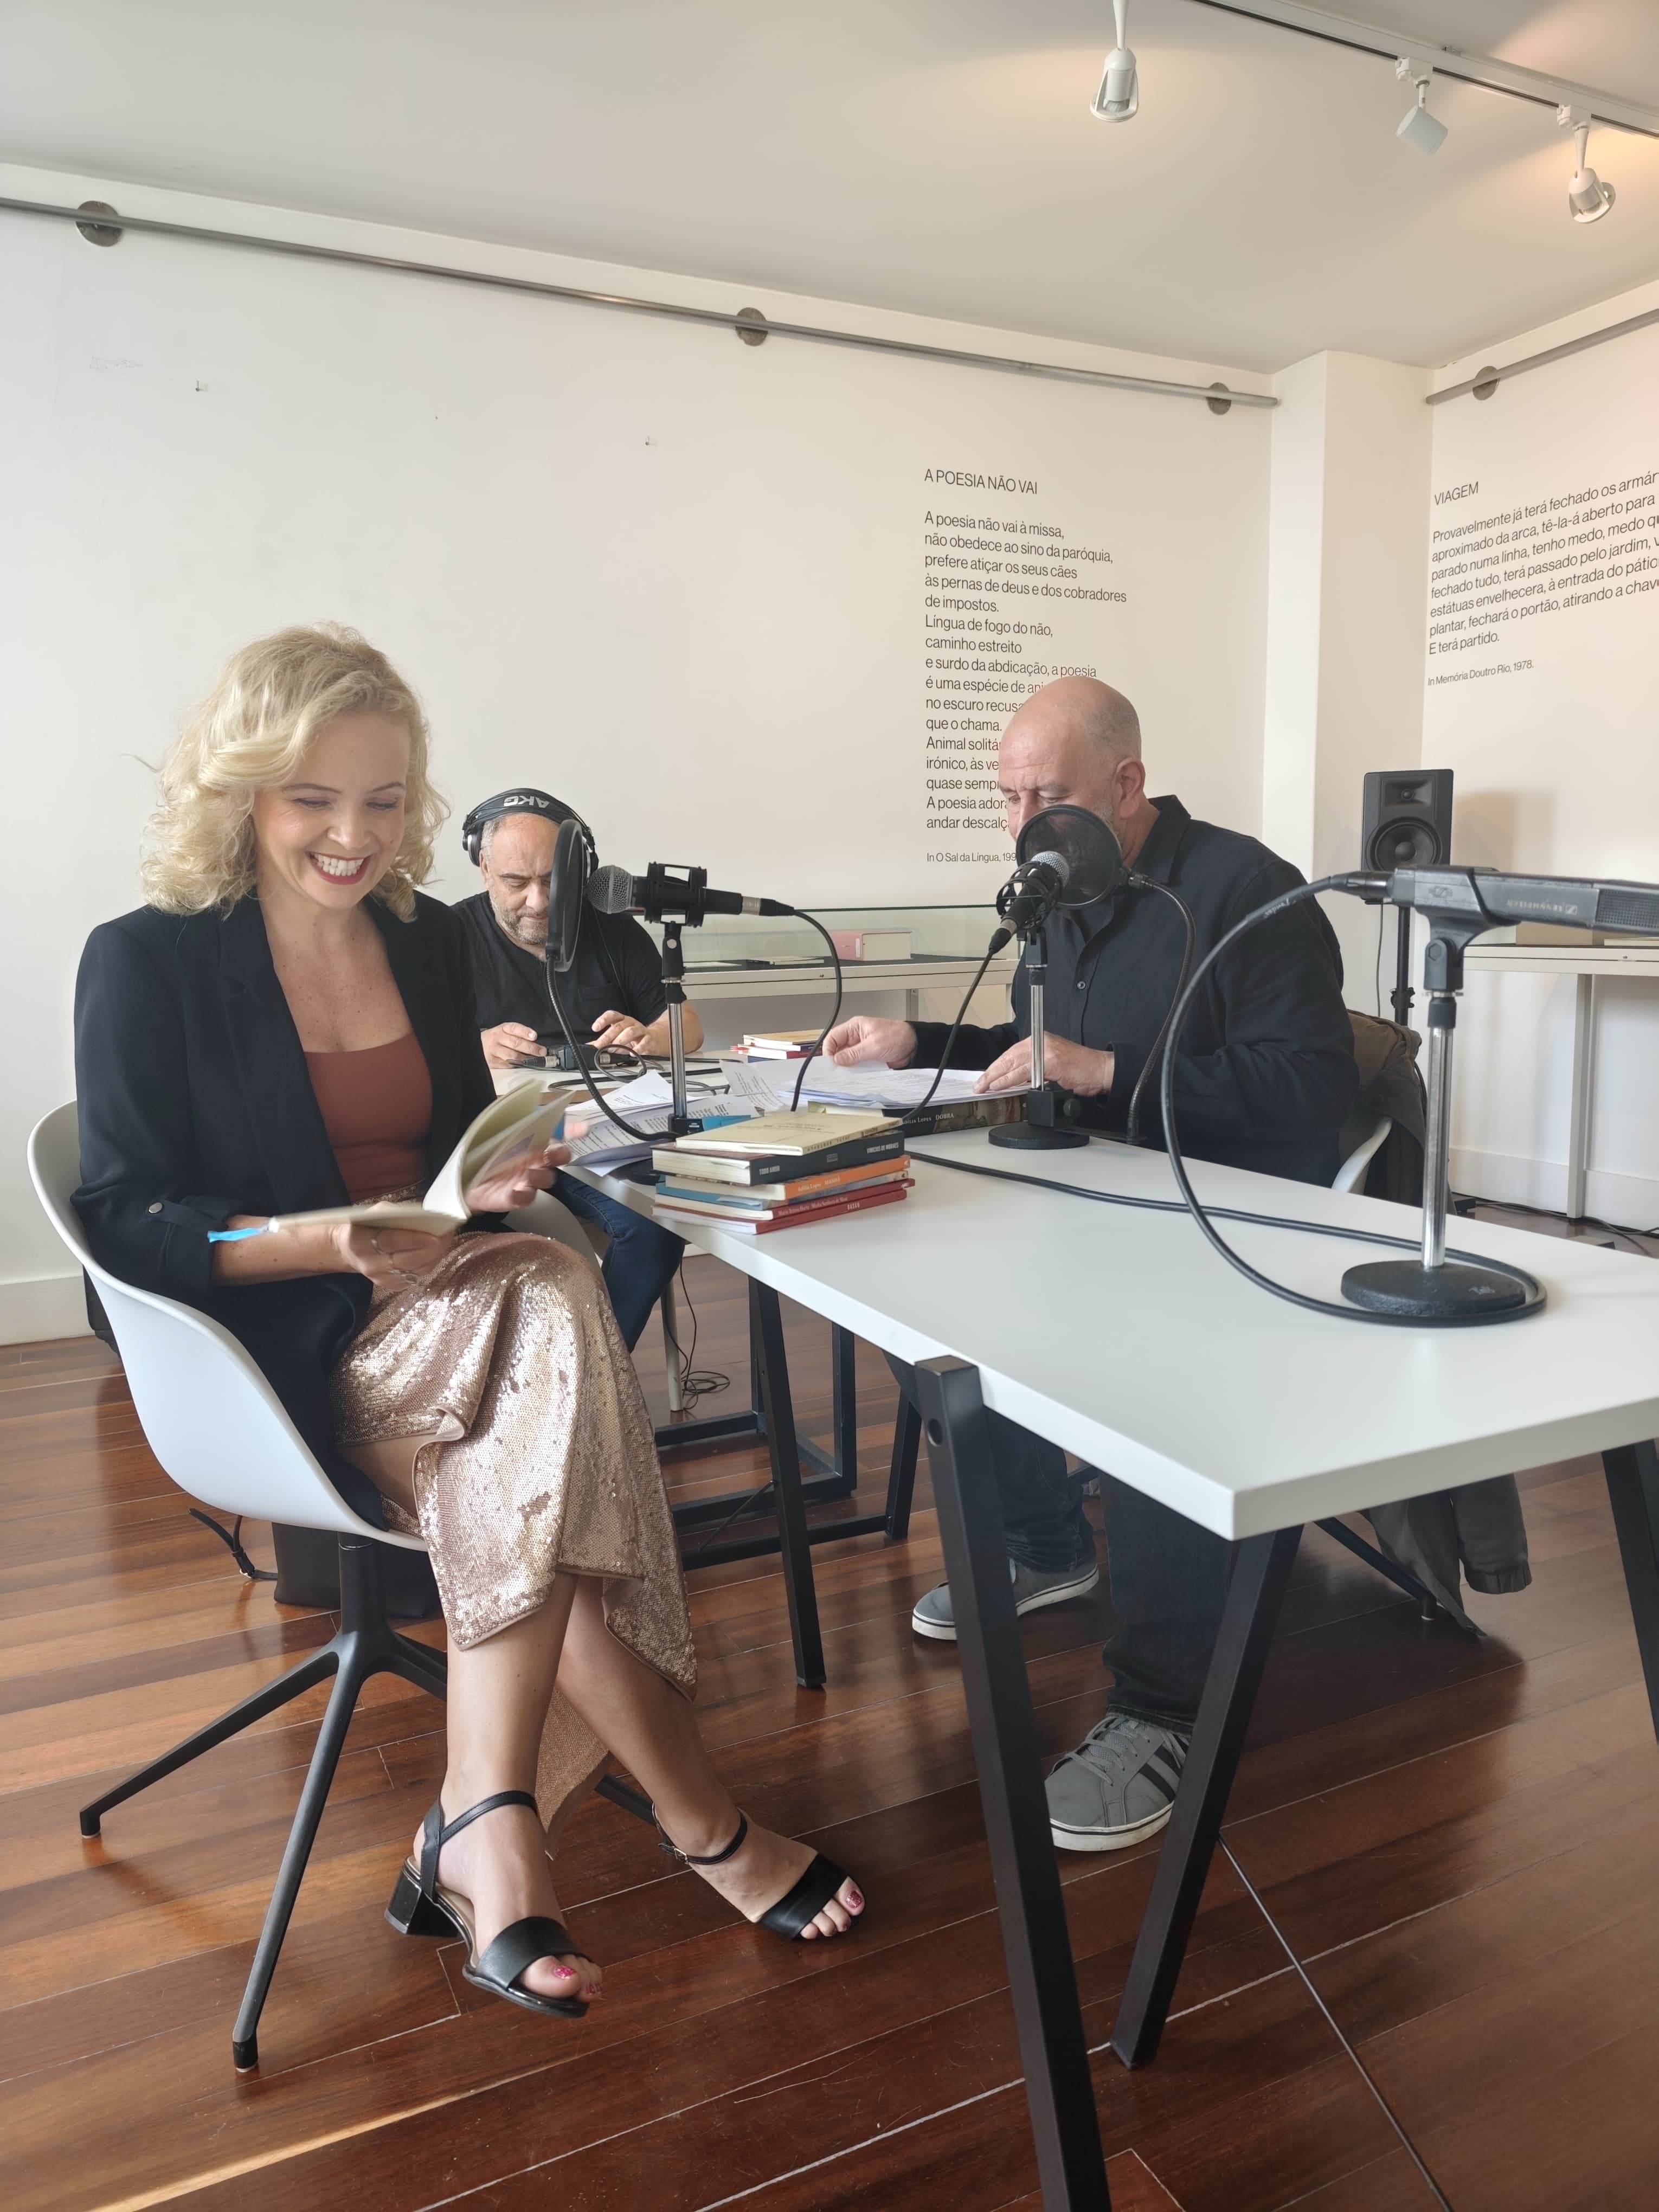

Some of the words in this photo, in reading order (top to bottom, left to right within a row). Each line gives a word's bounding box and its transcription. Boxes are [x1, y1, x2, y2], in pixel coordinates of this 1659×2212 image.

[924, 469, 934, 482] A
[937, 470, 985, 488] POESIA
[988, 475, 1015, 492] NÃO
[1019, 480, 1037, 494] VAI
[1435, 481, 1478, 505] VIAGEM
[1433, 513, 1510, 543] Provavelmente
[1512, 507, 1522, 524] já
[1525, 500, 1547, 518] terá
[1549, 488, 1598, 511] fechado
[1602, 484, 1616, 497] os
[1619, 471, 1659, 492] armár
[925, 511, 934, 524] A
[937, 515, 976, 529] poesia
[979, 518, 1000, 531] não
[1002, 520, 1017, 533] vai
[1020, 521, 1027, 533] à
[1030, 523, 1064, 539] missa,
[1432, 537, 1493, 563] aproximado
[1496, 532, 1509, 545] da
[1512, 526, 1539, 541] arca,
[1542, 512, 1579, 533] tê-la-á
[1582, 503, 1623, 522] aberto
[1626, 495, 1655, 514] para
[925, 533, 947, 546] não
[950, 535, 1002, 551] obedece
[1005, 543, 1018, 553] ao
[1021, 542, 1044, 555] sino
[1046, 544, 1060, 557] da
[1063, 547, 1114, 564] paróquia,
[1432, 562, 1468, 582] parado
[1470, 556, 1499, 571] numa
[1502, 548, 1529, 563] linha,
[1532, 538, 1565, 555] tenho
[1568, 528, 1605, 546] medo,
[1608, 517, 1644, 537] medo
[925, 554, 968, 569] prefere
[970, 558, 1003, 574] atiçar
[1006, 563, 1019, 573] os
[1021, 565, 1048, 576] seus
[1051, 565, 1077, 578] cães
[1431, 580, 1472, 599] fechado
[1475, 573, 1501, 588] tudo,
[1504, 565, 1525, 581] terá
[1528, 554, 1578, 579] passado
[1580, 548, 1606, 566] pelo
[1608, 538, 1650, 560] jardim,
[925, 573, 939, 587] às
[942, 578, 982, 590] pernas
[985, 578, 999, 591] de
[1002, 580, 1030, 594] deus
[1032, 586, 1039, 595] e
[1041, 583, 1062, 597] dos
[1064, 586, 1126, 602] cobradores
[1431, 600, 1474, 617] estátuas
[1476, 584, 1546, 608] envelhecera,
[1548, 578, 1555, 591] à
[1558, 568, 1604, 588] entrada
[1607, 564, 1623, 578] do
[925, 594, 940, 607] de
[943, 595, 999, 612] impostos.
[1430, 620, 1466, 638] plantar,
[1469, 608, 1509, 627] fechará
[1512, 609, 1518, 619] o
[1521, 599, 1560, 619] portão,
[1563, 587, 1613, 608] atirando
[1616, 587, 1623, 597] a
[1626, 579, 1657, 594] chav
[926, 614, 965, 631] Língua
[968, 618, 982, 631] de
[985, 619, 1011, 635] fogo
[1013, 621, 1027, 634] do
[1030, 623, 1052, 638] não,
[925, 636, 976, 651] caminho
[979, 640, 1021, 653] estreito
[1430, 642, 1436, 654] E
[1439, 638, 1458, 653] terá
[1460, 631, 1499, 651] partido.
[926, 659, 933, 668] e
[936, 657, 969, 670] surdo
[972, 658, 986, 671] da
[988, 659, 1049, 677] abdicação,
[1052, 666, 1058, 675] a
[1061, 665, 1096, 677] poesia
[1436, 670, 1468, 684] Memória
[1470, 668, 1496, 678] Doutro
[1497, 664, 1512, 674] Rio,
[1514, 660, 1533, 671] 1978.
[926, 676, 933, 688] é
[936, 679, 961, 690] uma
[963, 679, 1008, 693] espécie
[1011, 680, 1025, 693] de
[927, 699, 941, 709] no
[943, 700, 983, 711] escuro
[926, 719, 948, 731] que
[951, 721, 958, 730] o
[961, 718, 1002, 731] chama.
[926, 736, 965, 750] Animal
[927, 756, 968, 771] irónico,
[970, 757, 983, 770] às
[986, 761, 999, 770] ve
[927, 779, 962, 791] quase
[504, 795, 550, 808] AKG
[927, 796, 935, 808] A
[938, 796, 976, 811] poesia
[927, 816, 960, 828] andar
[963, 816, 1009, 831] descalç
[927, 853, 934, 861] In
[936, 853, 943, 861] O
[946, 853, 958, 861] Sal
[960, 853, 970, 861] da
[972, 853, 1001, 863] Língua,
[1002, 853, 1016, 862] 199
[1507, 900, 1562, 912] SENNHEISER
